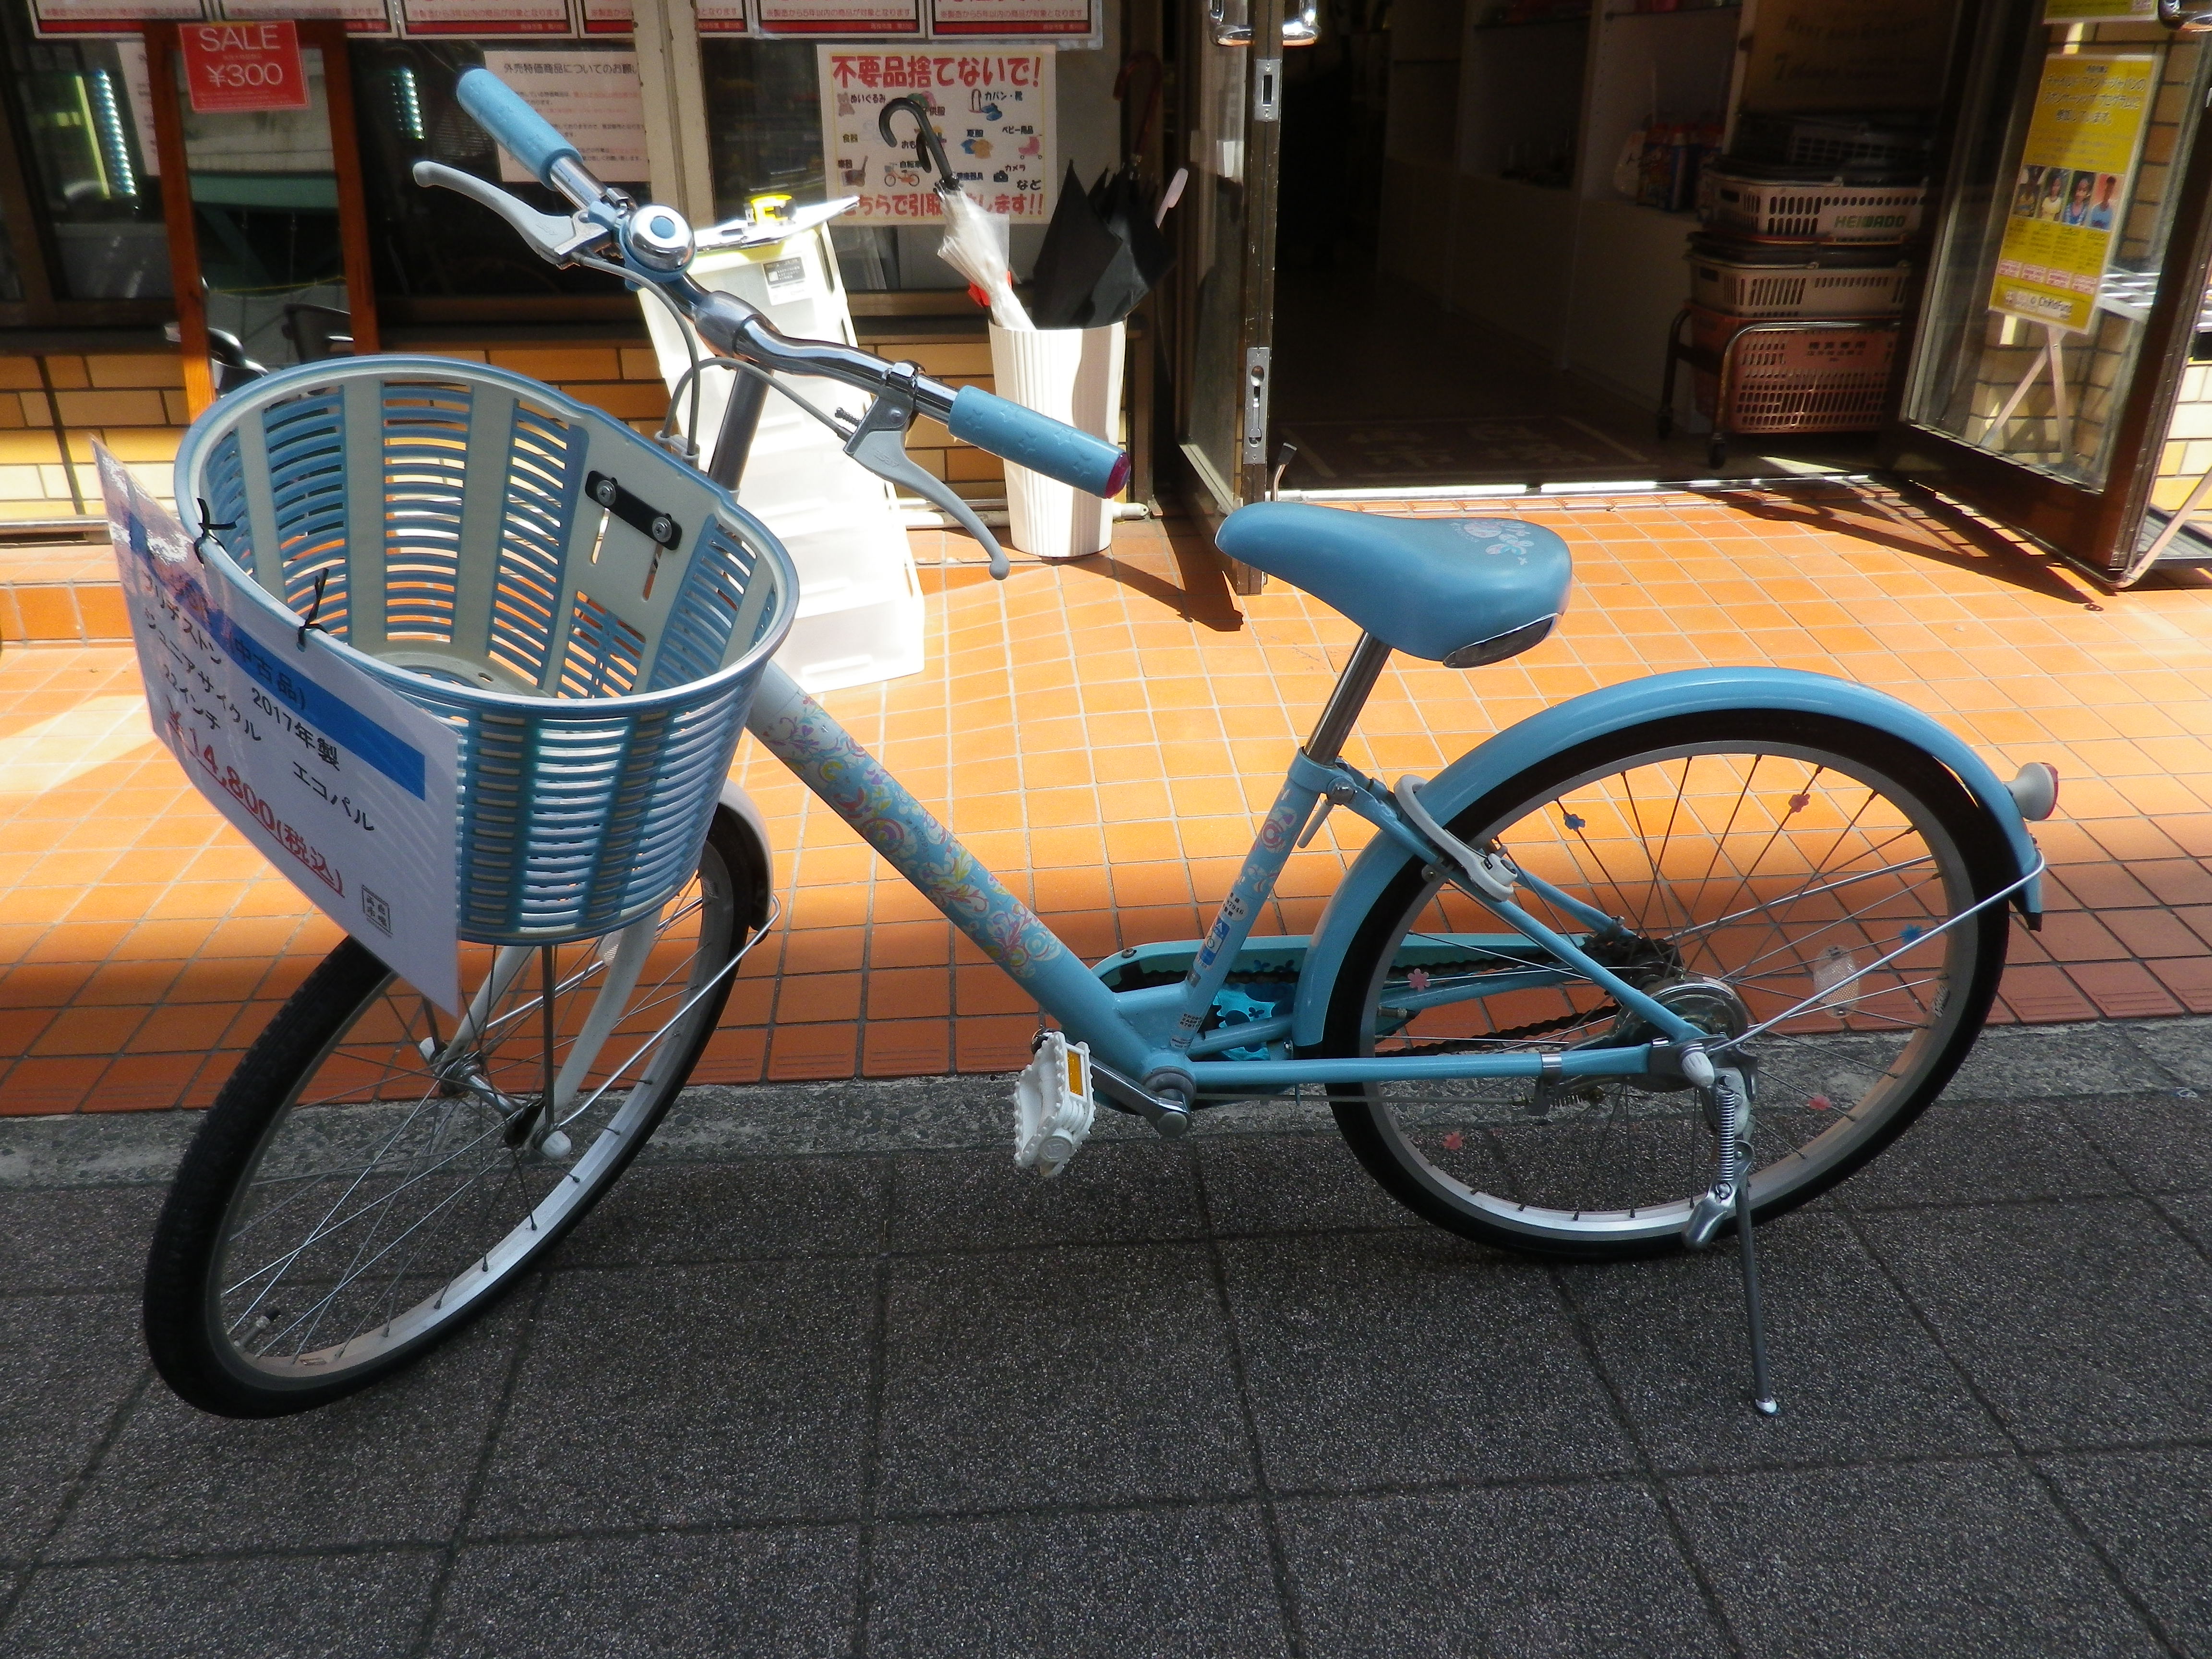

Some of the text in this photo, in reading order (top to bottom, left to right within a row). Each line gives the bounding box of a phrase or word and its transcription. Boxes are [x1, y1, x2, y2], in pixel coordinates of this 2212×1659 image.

[199, 24, 281, 52] SALE
[206, 63, 283, 88] ¥300
[831, 55, 1041, 89] 不要品捨てないで!
[850, 94, 887, 104] ぬいぐるみ
[1016, 180, 1041, 191] など
[1834, 215, 1906, 228] HEIWADO
[251, 687, 340, 772] 2017年製
[292, 761, 374, 831] エコパル
